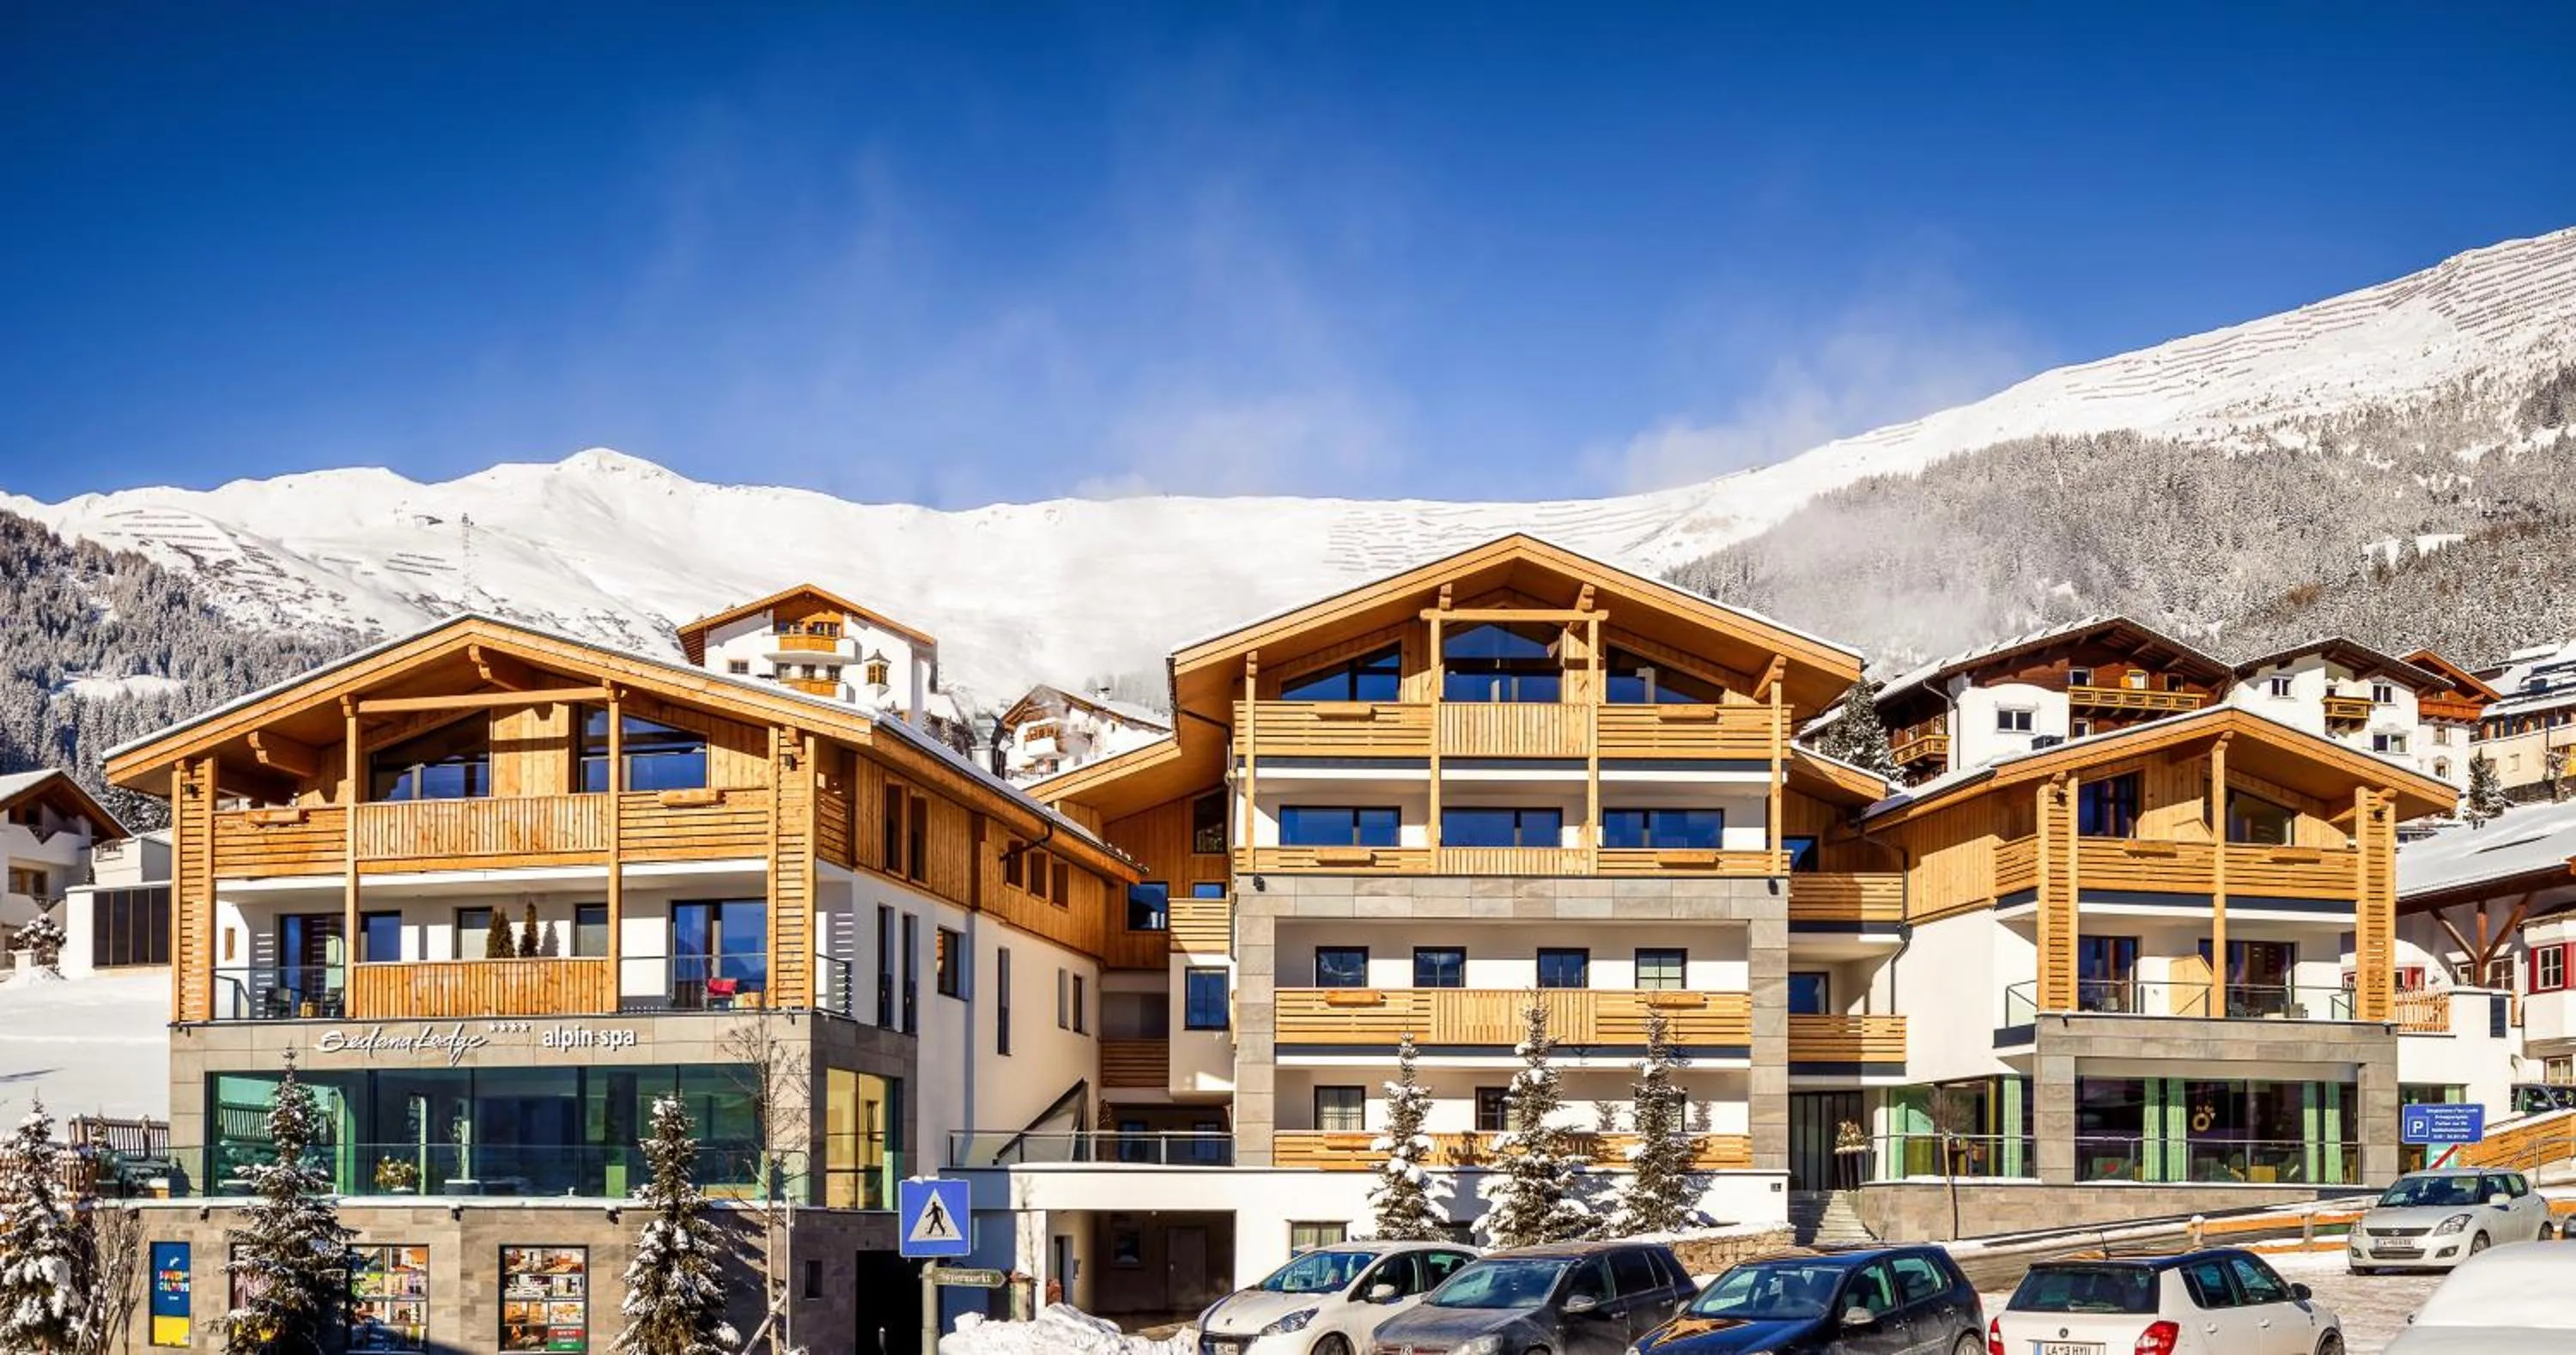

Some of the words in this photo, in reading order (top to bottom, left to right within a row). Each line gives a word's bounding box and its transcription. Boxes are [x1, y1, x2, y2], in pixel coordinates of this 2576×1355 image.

[543, 1024, 594, 1053] alpin
[599, 1030, 637, 1051] spa
[2413, 1121, 2423, 1133] P
